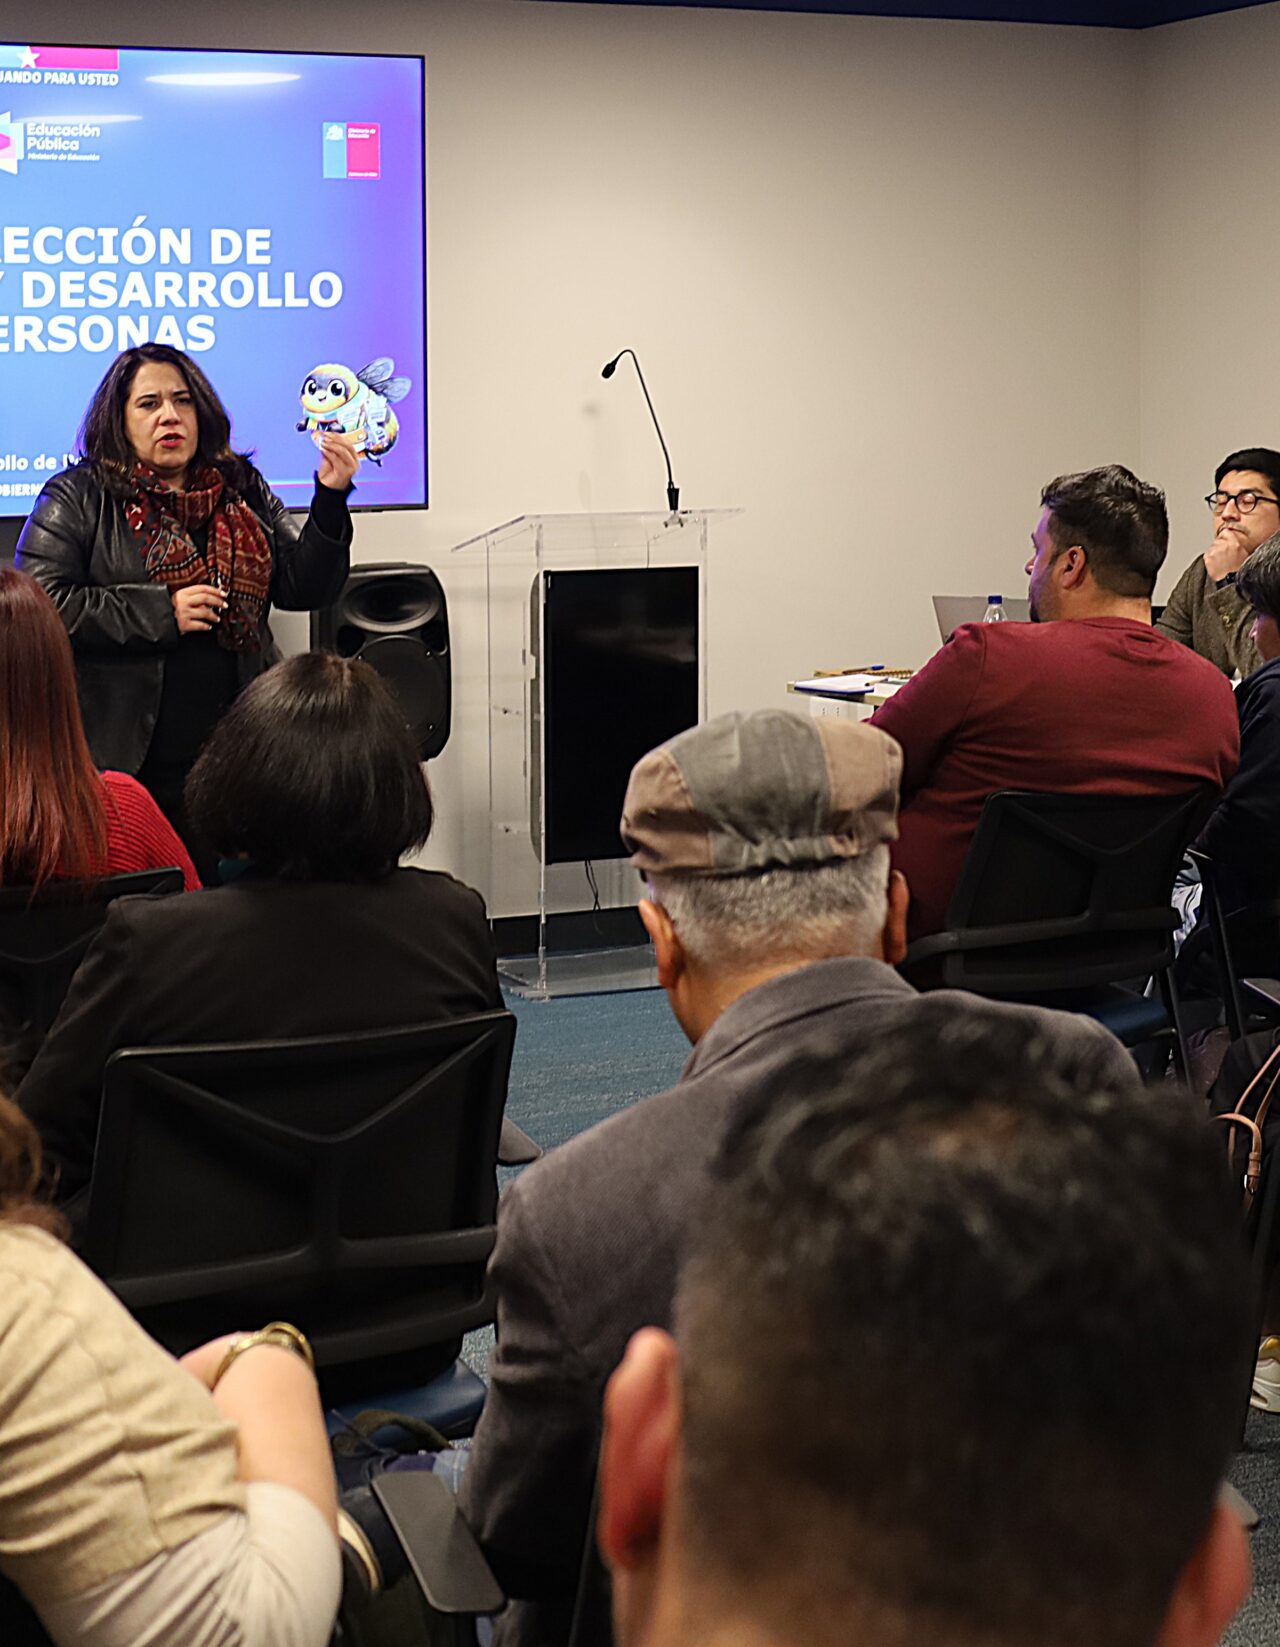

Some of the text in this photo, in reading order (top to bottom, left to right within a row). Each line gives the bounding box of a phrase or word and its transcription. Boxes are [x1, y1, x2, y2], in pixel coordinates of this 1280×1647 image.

[44, 72, 75, 84] PARA
[78, 73, 119, 86] USTED
[26, 122, 100, 137] Educación
[27, 137, 79, 151] Pública
[210, 228, 271, 265] DE
[22, 270, 343, 309] DESARROLLO
[33, 453, 58, 471] de
